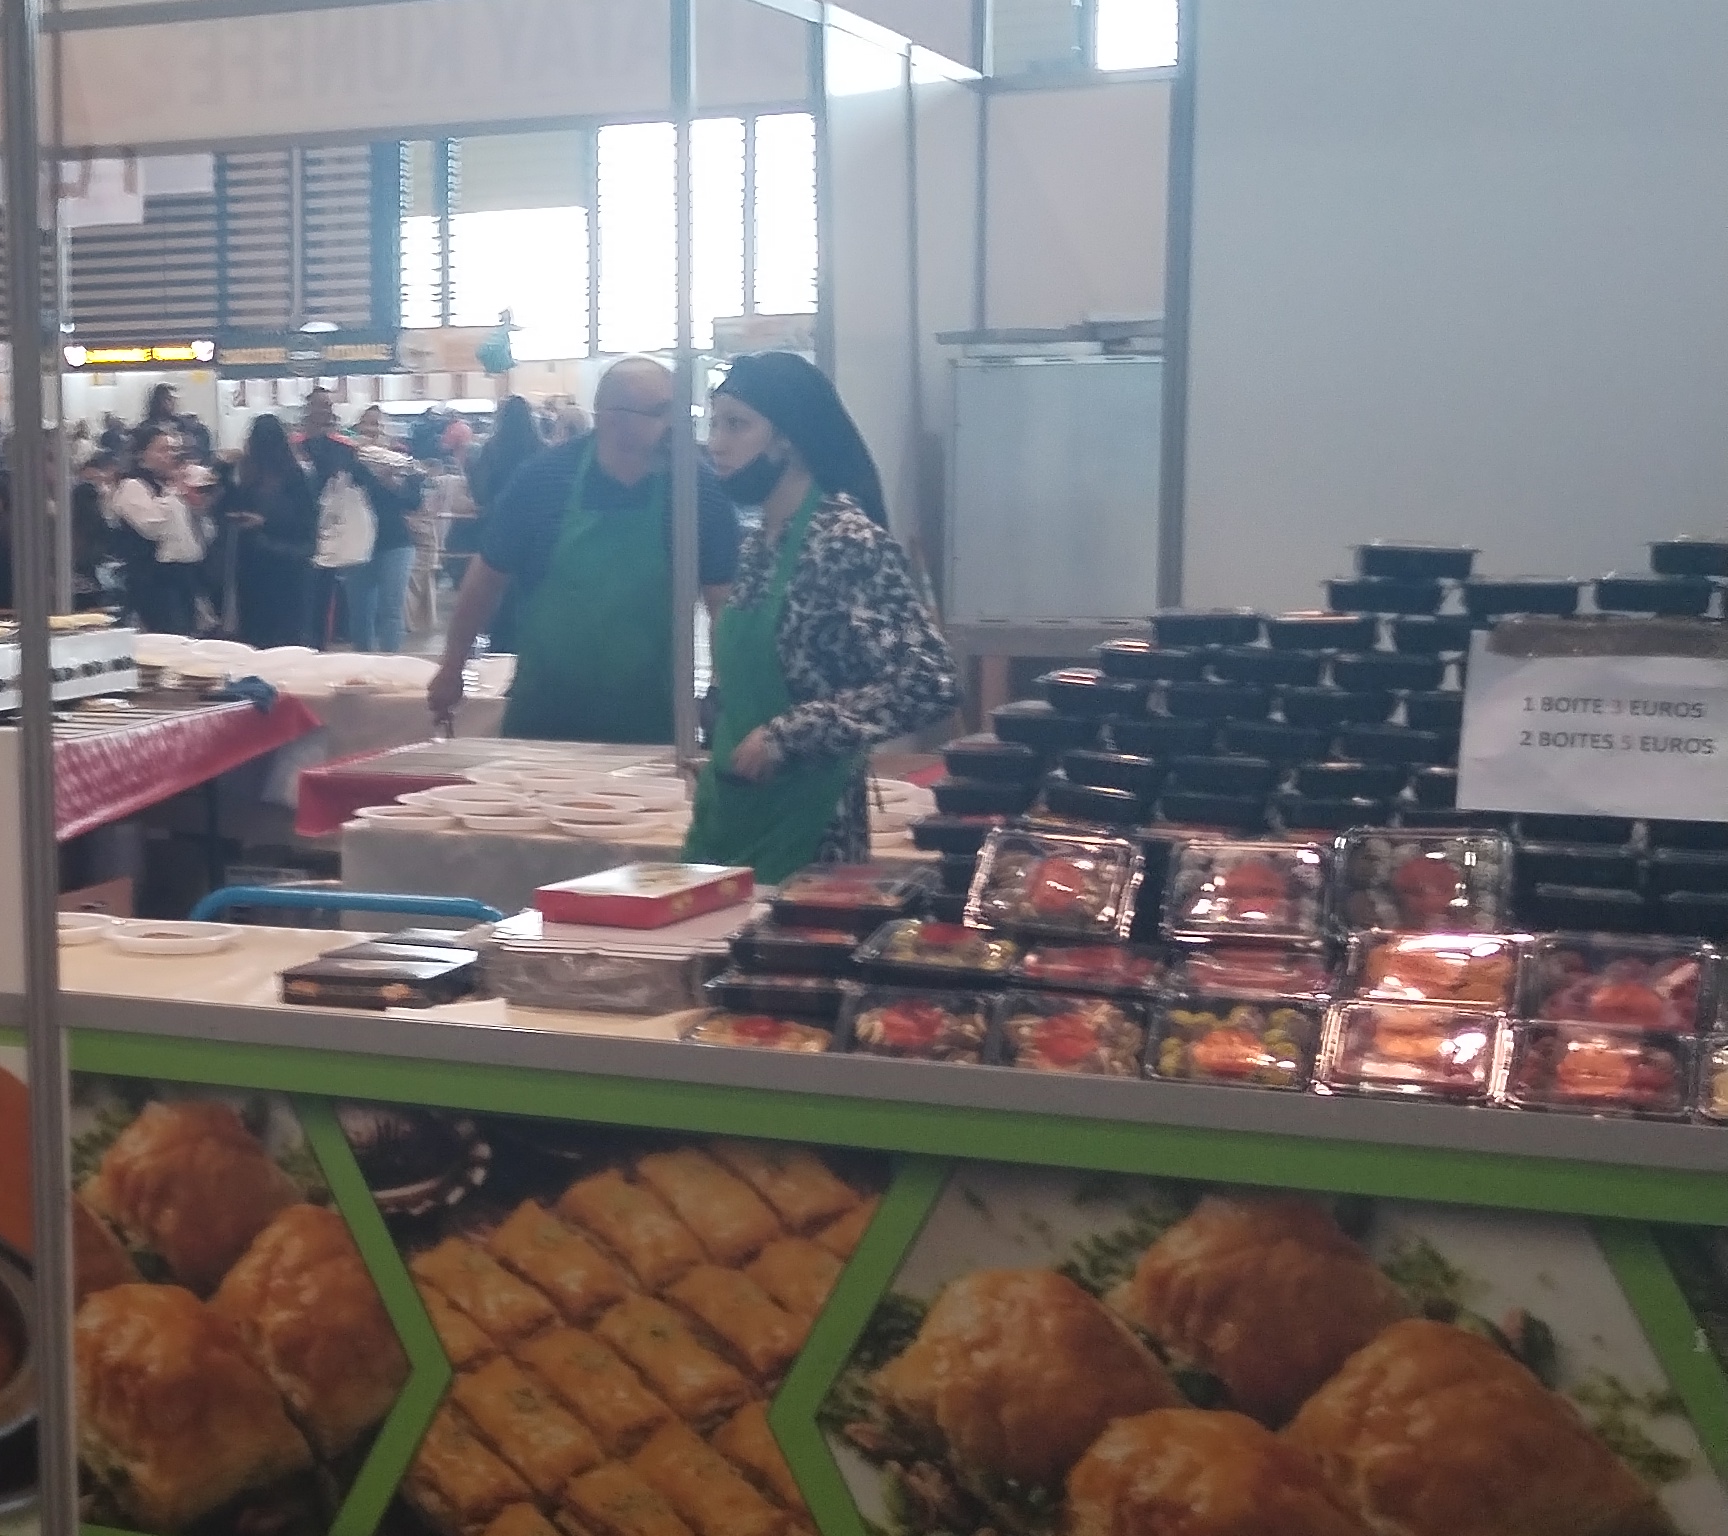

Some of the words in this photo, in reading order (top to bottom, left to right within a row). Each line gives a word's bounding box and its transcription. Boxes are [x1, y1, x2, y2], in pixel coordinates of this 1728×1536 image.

[1523, 697, 1535, 712] 1
[1540, 696, 1604, 714] BOITE
[1629, 699, 1706, 718] EUROS
[1520, 731, 1532, 746] 2
[1538, 731, 1614, 750] BOITES
[1640, 736, 1715, 755] EUROS
